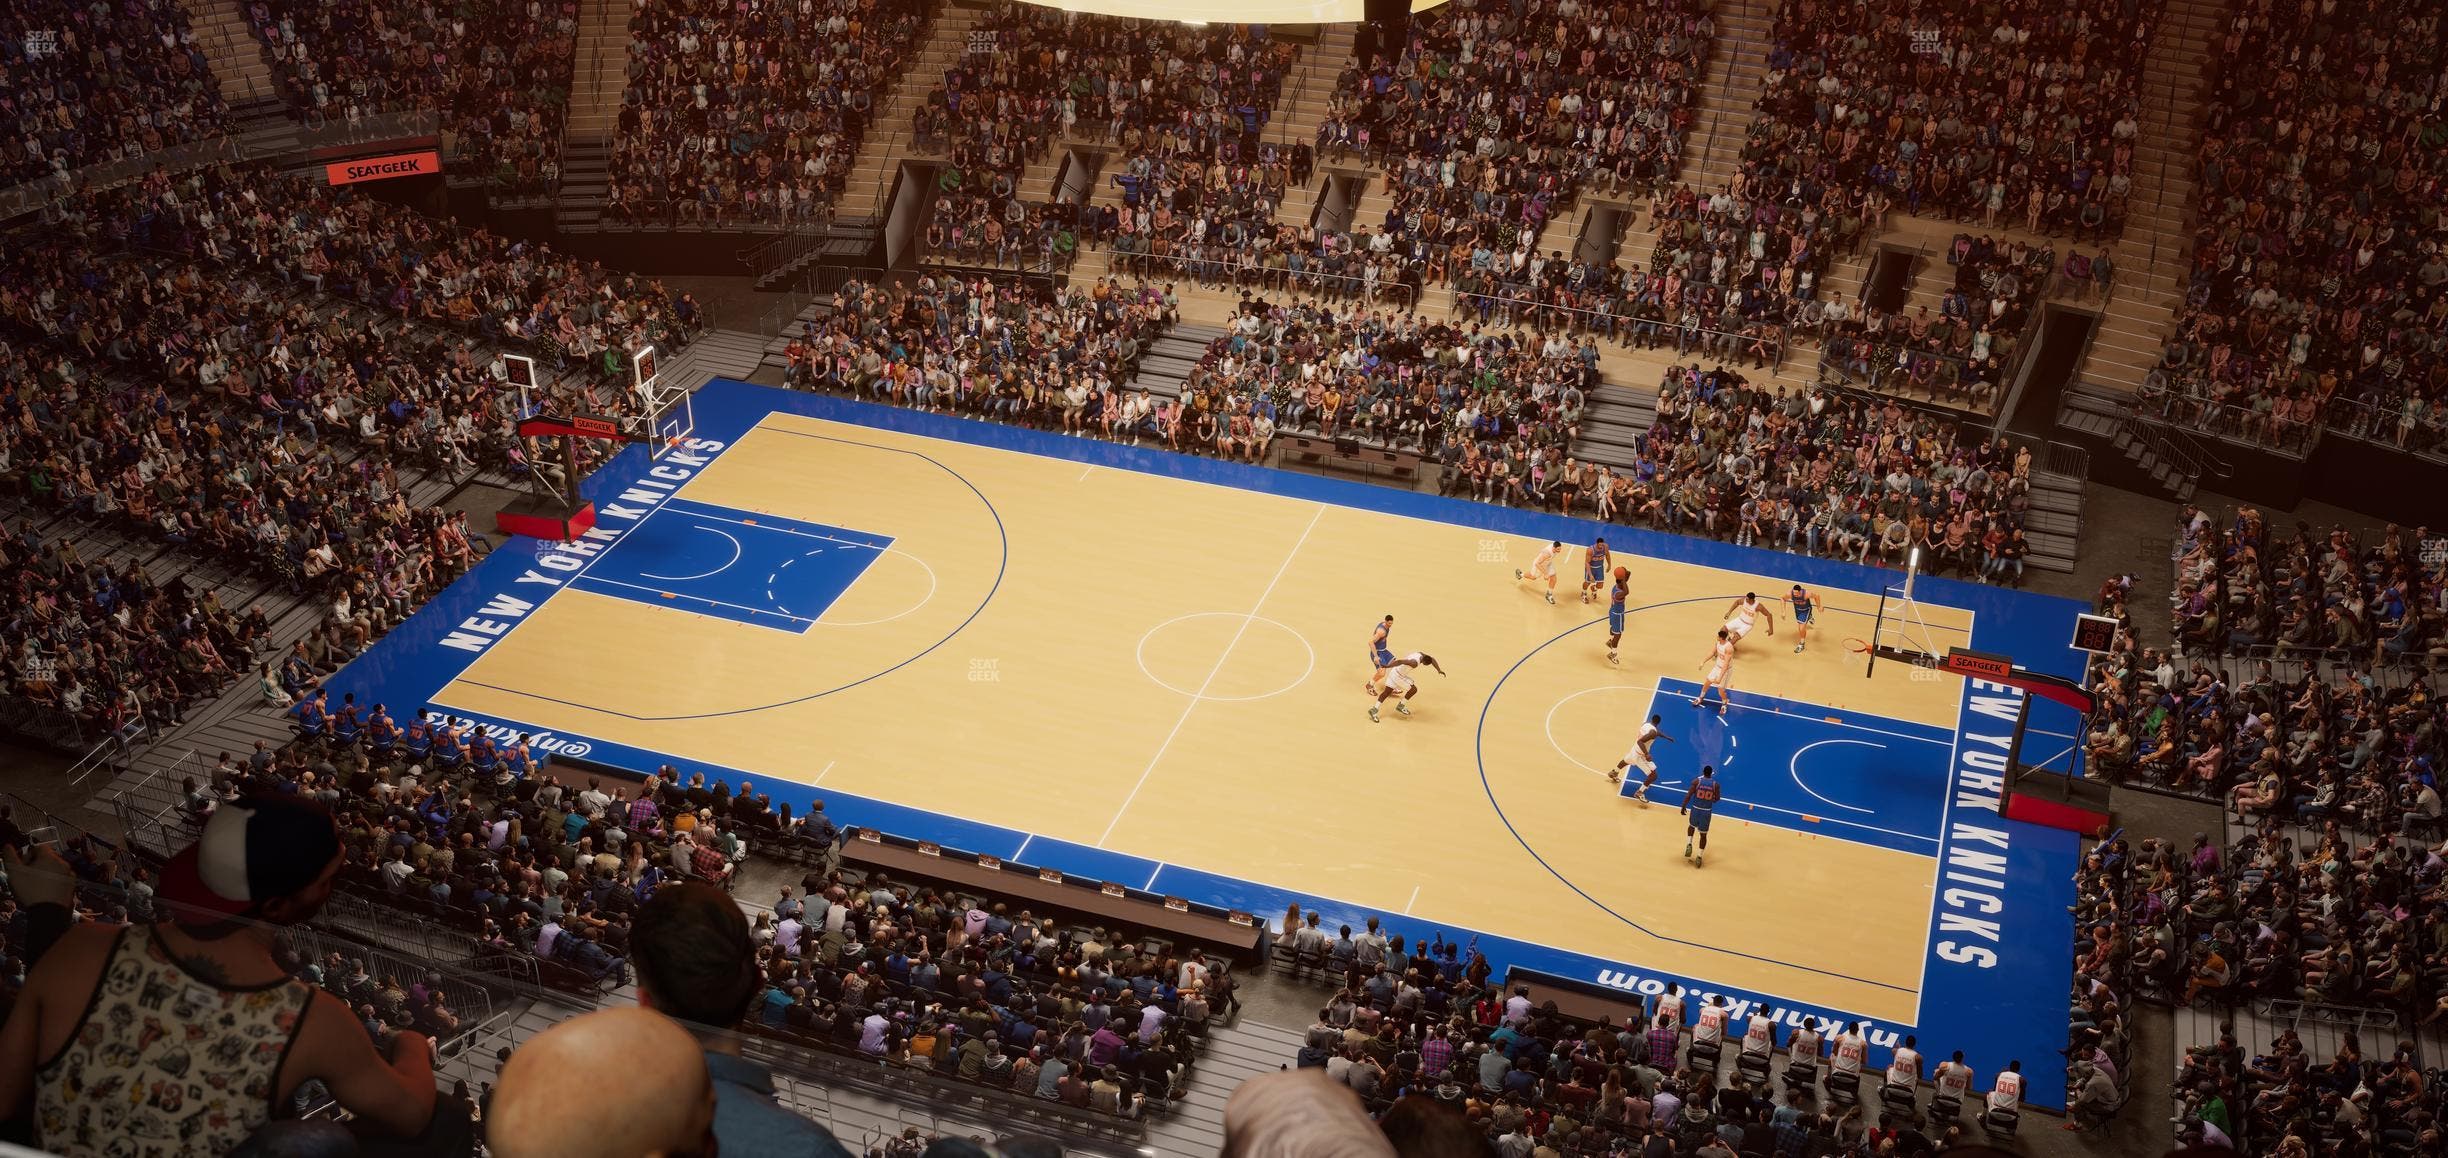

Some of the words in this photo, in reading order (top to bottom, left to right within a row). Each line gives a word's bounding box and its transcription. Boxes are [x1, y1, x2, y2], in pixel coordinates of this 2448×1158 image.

[347, 159, 420, 179] SEATGEEK
[577, 419, 613, 433] SEATGEEK
[439, 594, 535, 652] NEW
[514, 526, 623, 586] YORK
[600, 438, 725, 520] KNICKS
[1955, 656, 2003, 674] SEATGEEK
[1969, 664, 2026, 722] EW
[426, 711, 592, 758] @nyknicks
[1956, 732, 2013, 813] YORK
[1696, 789, 1713, 801] 00
[1936, 822, 2010, 969] KNICKS
[1701, 1014, 1718, 1030] 00
[1997, 1081, 2017, 1096] 00
